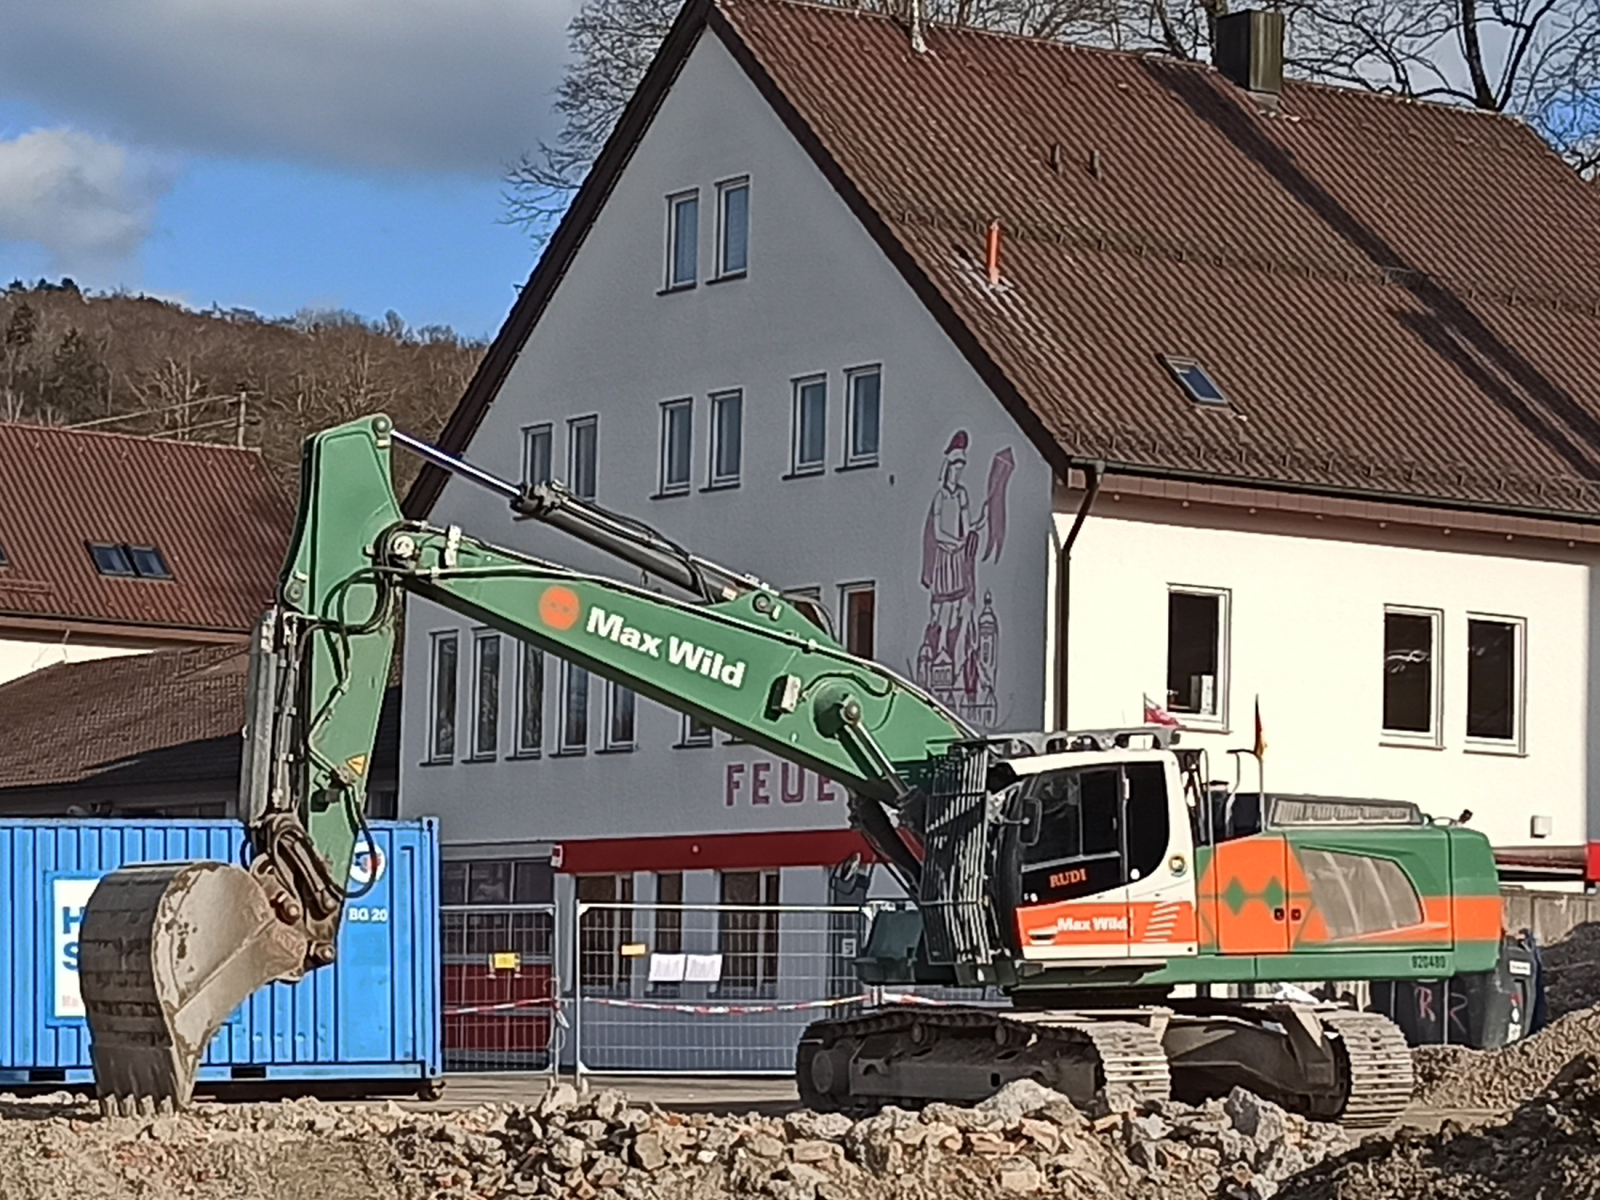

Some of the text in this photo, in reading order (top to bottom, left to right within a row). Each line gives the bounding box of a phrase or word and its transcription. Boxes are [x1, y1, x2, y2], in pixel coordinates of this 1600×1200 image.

[586, 606, 746, 688] Max Wild
[1049, 868, 1087, 888] RUDI
[348, 907, 388, 922] BG 20
[1057, 916, 1128, 931] Max Wild
